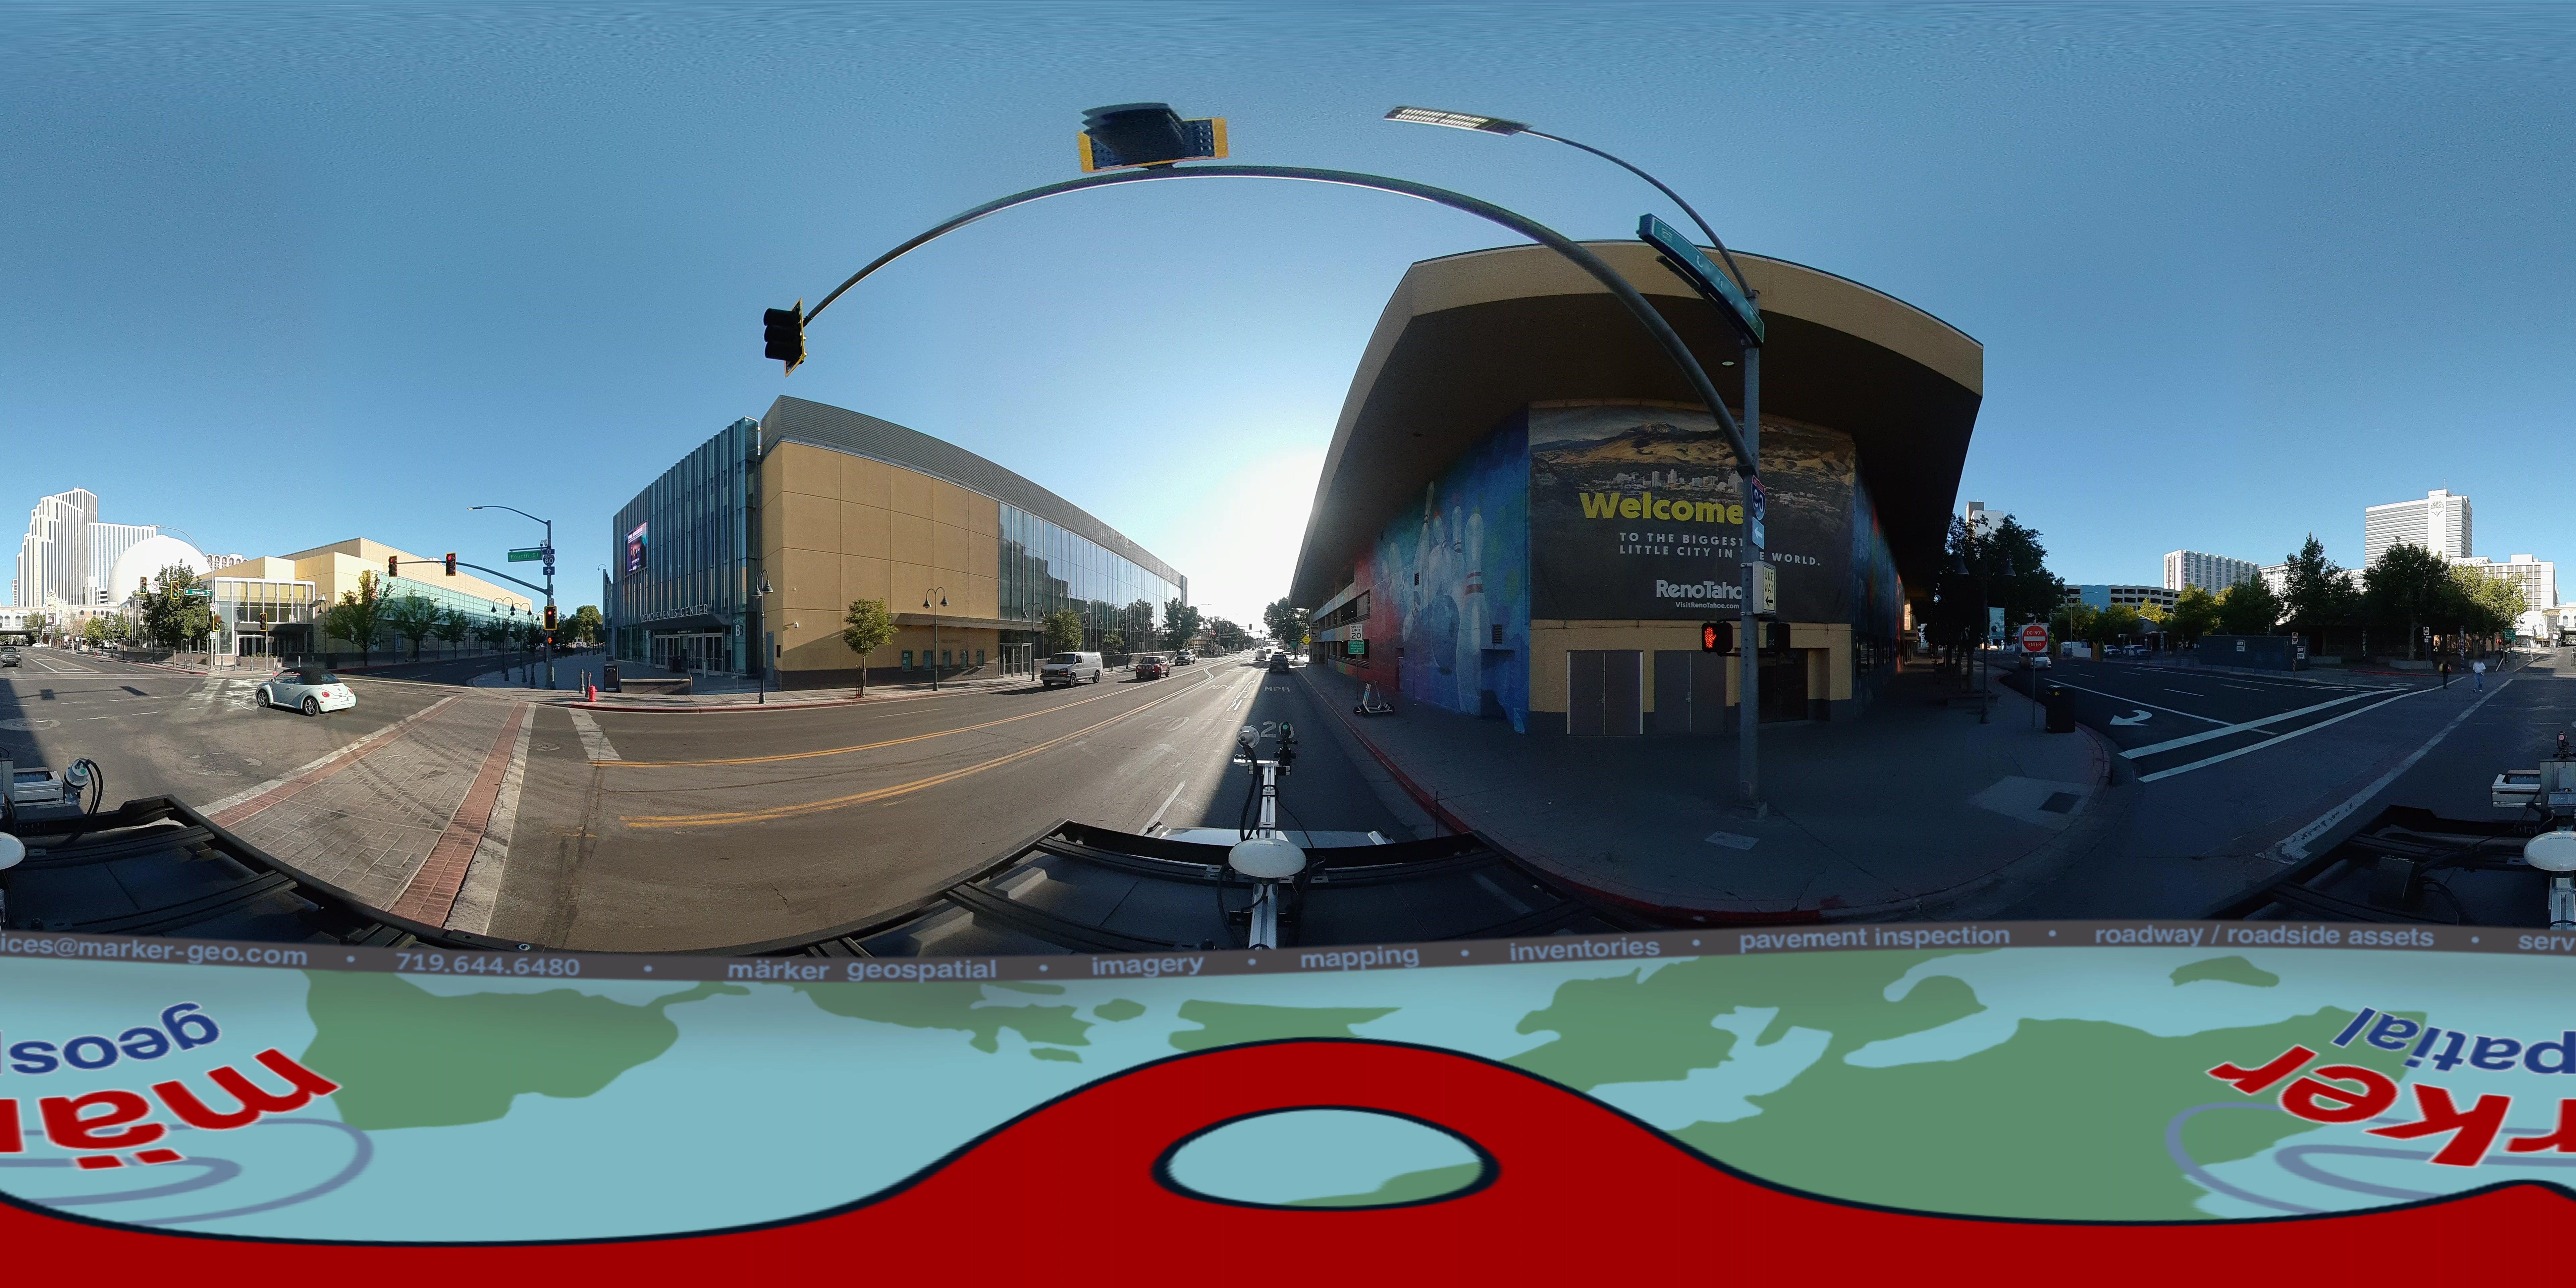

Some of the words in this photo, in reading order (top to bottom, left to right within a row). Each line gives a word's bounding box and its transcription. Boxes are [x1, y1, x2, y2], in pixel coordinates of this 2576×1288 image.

[1579, 492, 1743, 525] Welcome
[1620, 532, 1639, 541] TO
[1647, 533, 1674, 543] THE
[1683, 534, 1743, 547] BIGGEST
[1620, 545, 1669, 555] LITTLE
[1677, 547, 1710, 557] CITY
[1719, 549, 1732, 558] IN
[1772, 552, 1820, 566] WORLD.
[1765, 571, 1773, 582] ONE
[1656, 580, 1742, 599] RenoTaho
[1765, 583, 1773, 593] WAY
[642, 613, 654, 621] RENO
[656, 608, 677, 620] EVENTS
[681, 604, 708, 616] CENTER
[1144, 716, 1189, 731] 20
[1260, 721, 1294, 738] 20
